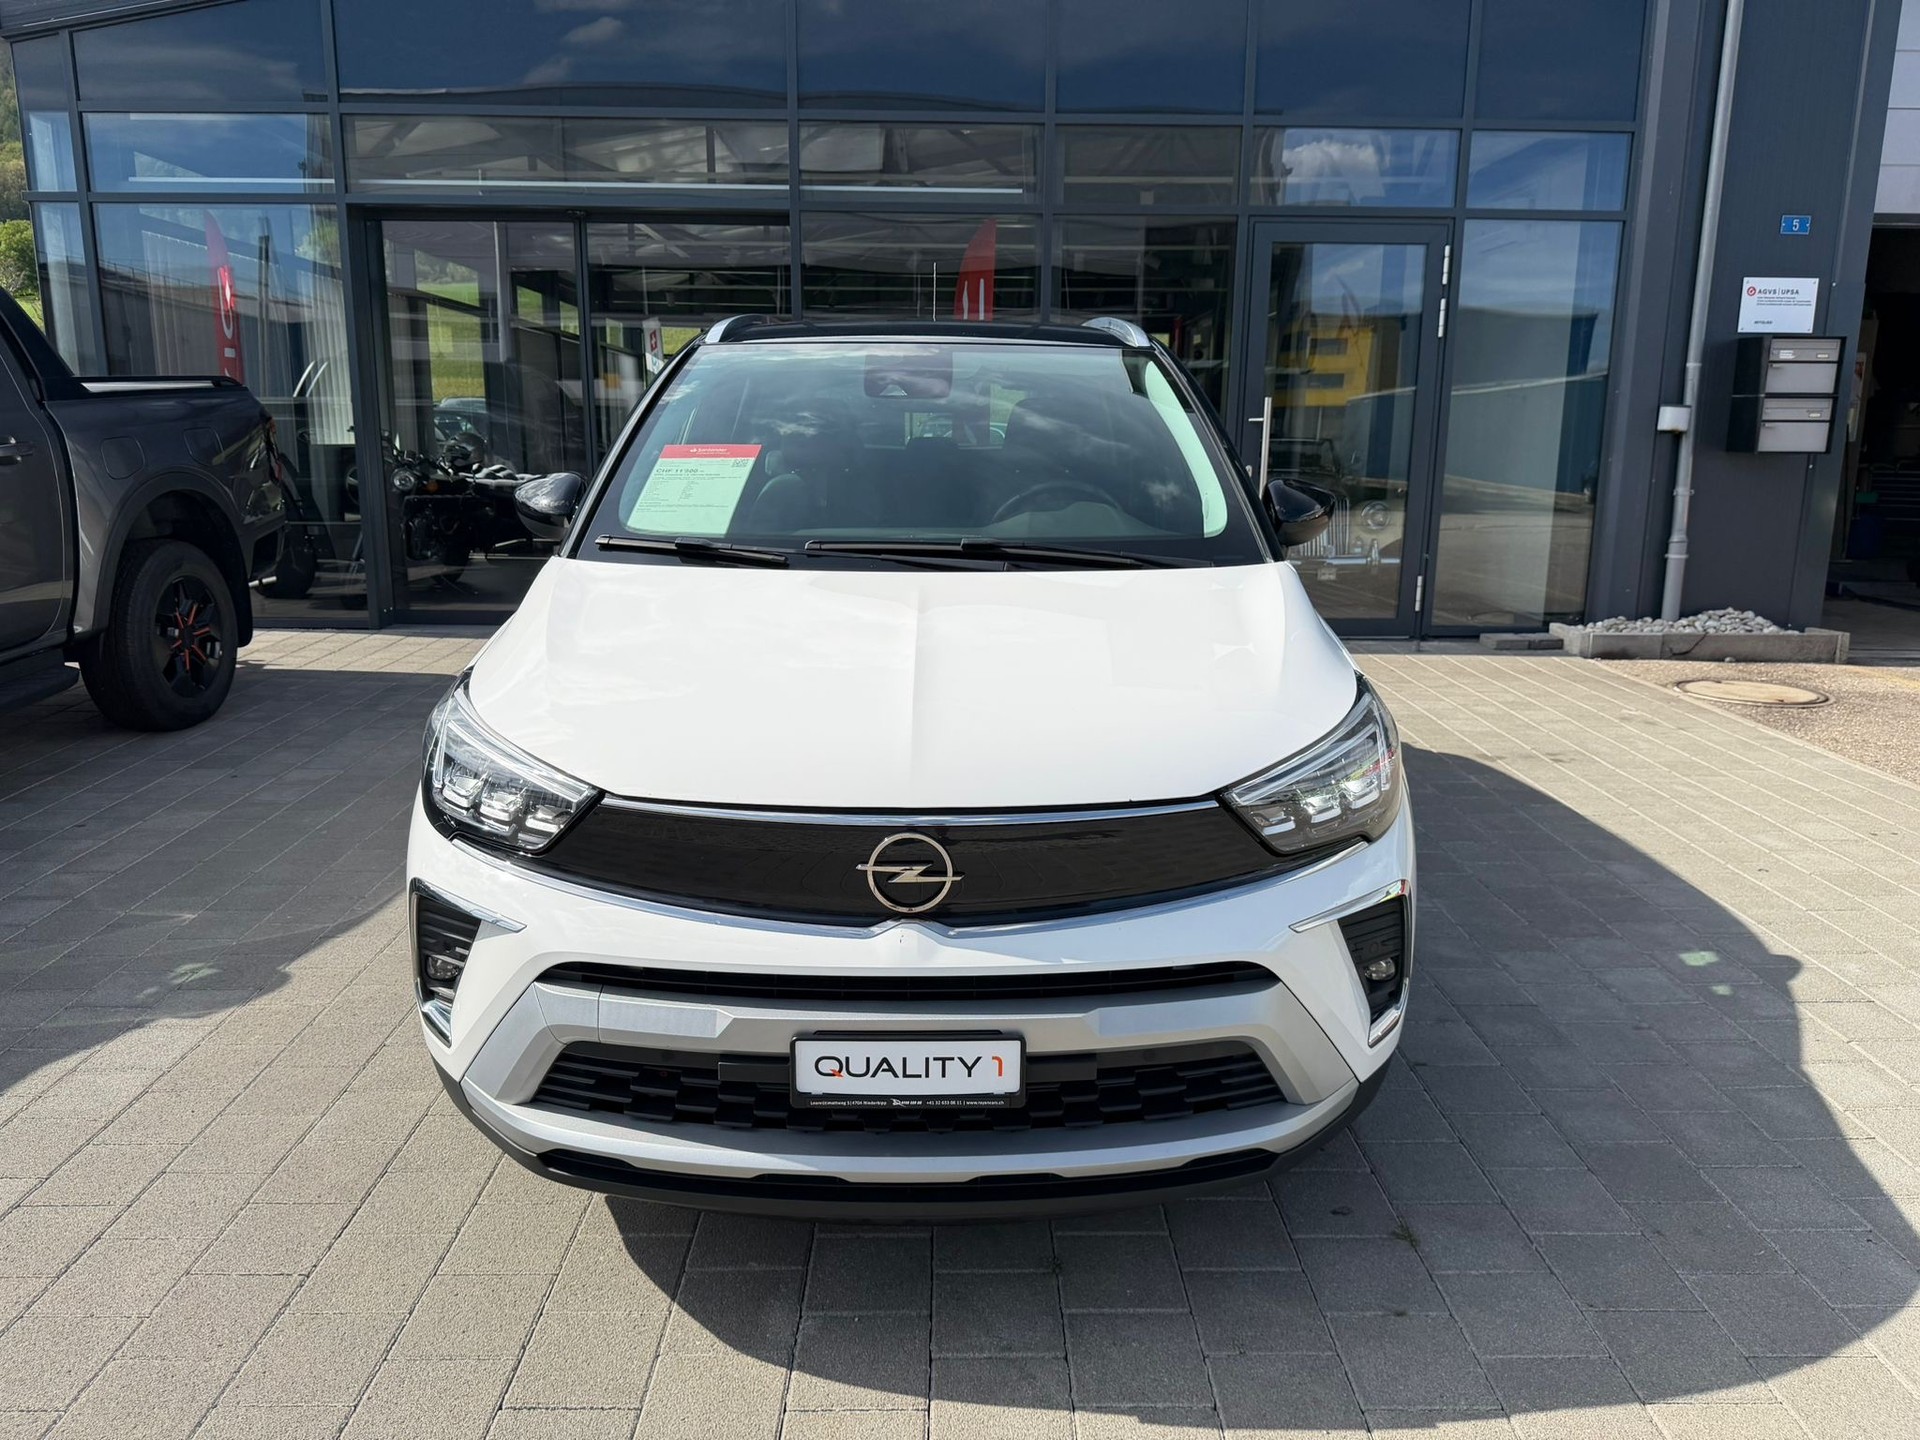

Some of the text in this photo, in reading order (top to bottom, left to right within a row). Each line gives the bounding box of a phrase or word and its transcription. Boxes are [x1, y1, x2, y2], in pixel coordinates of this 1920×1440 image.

[1792, 219, 1800, 231] 5
[814, 1055, 1003, 1078] QUALITY 1
